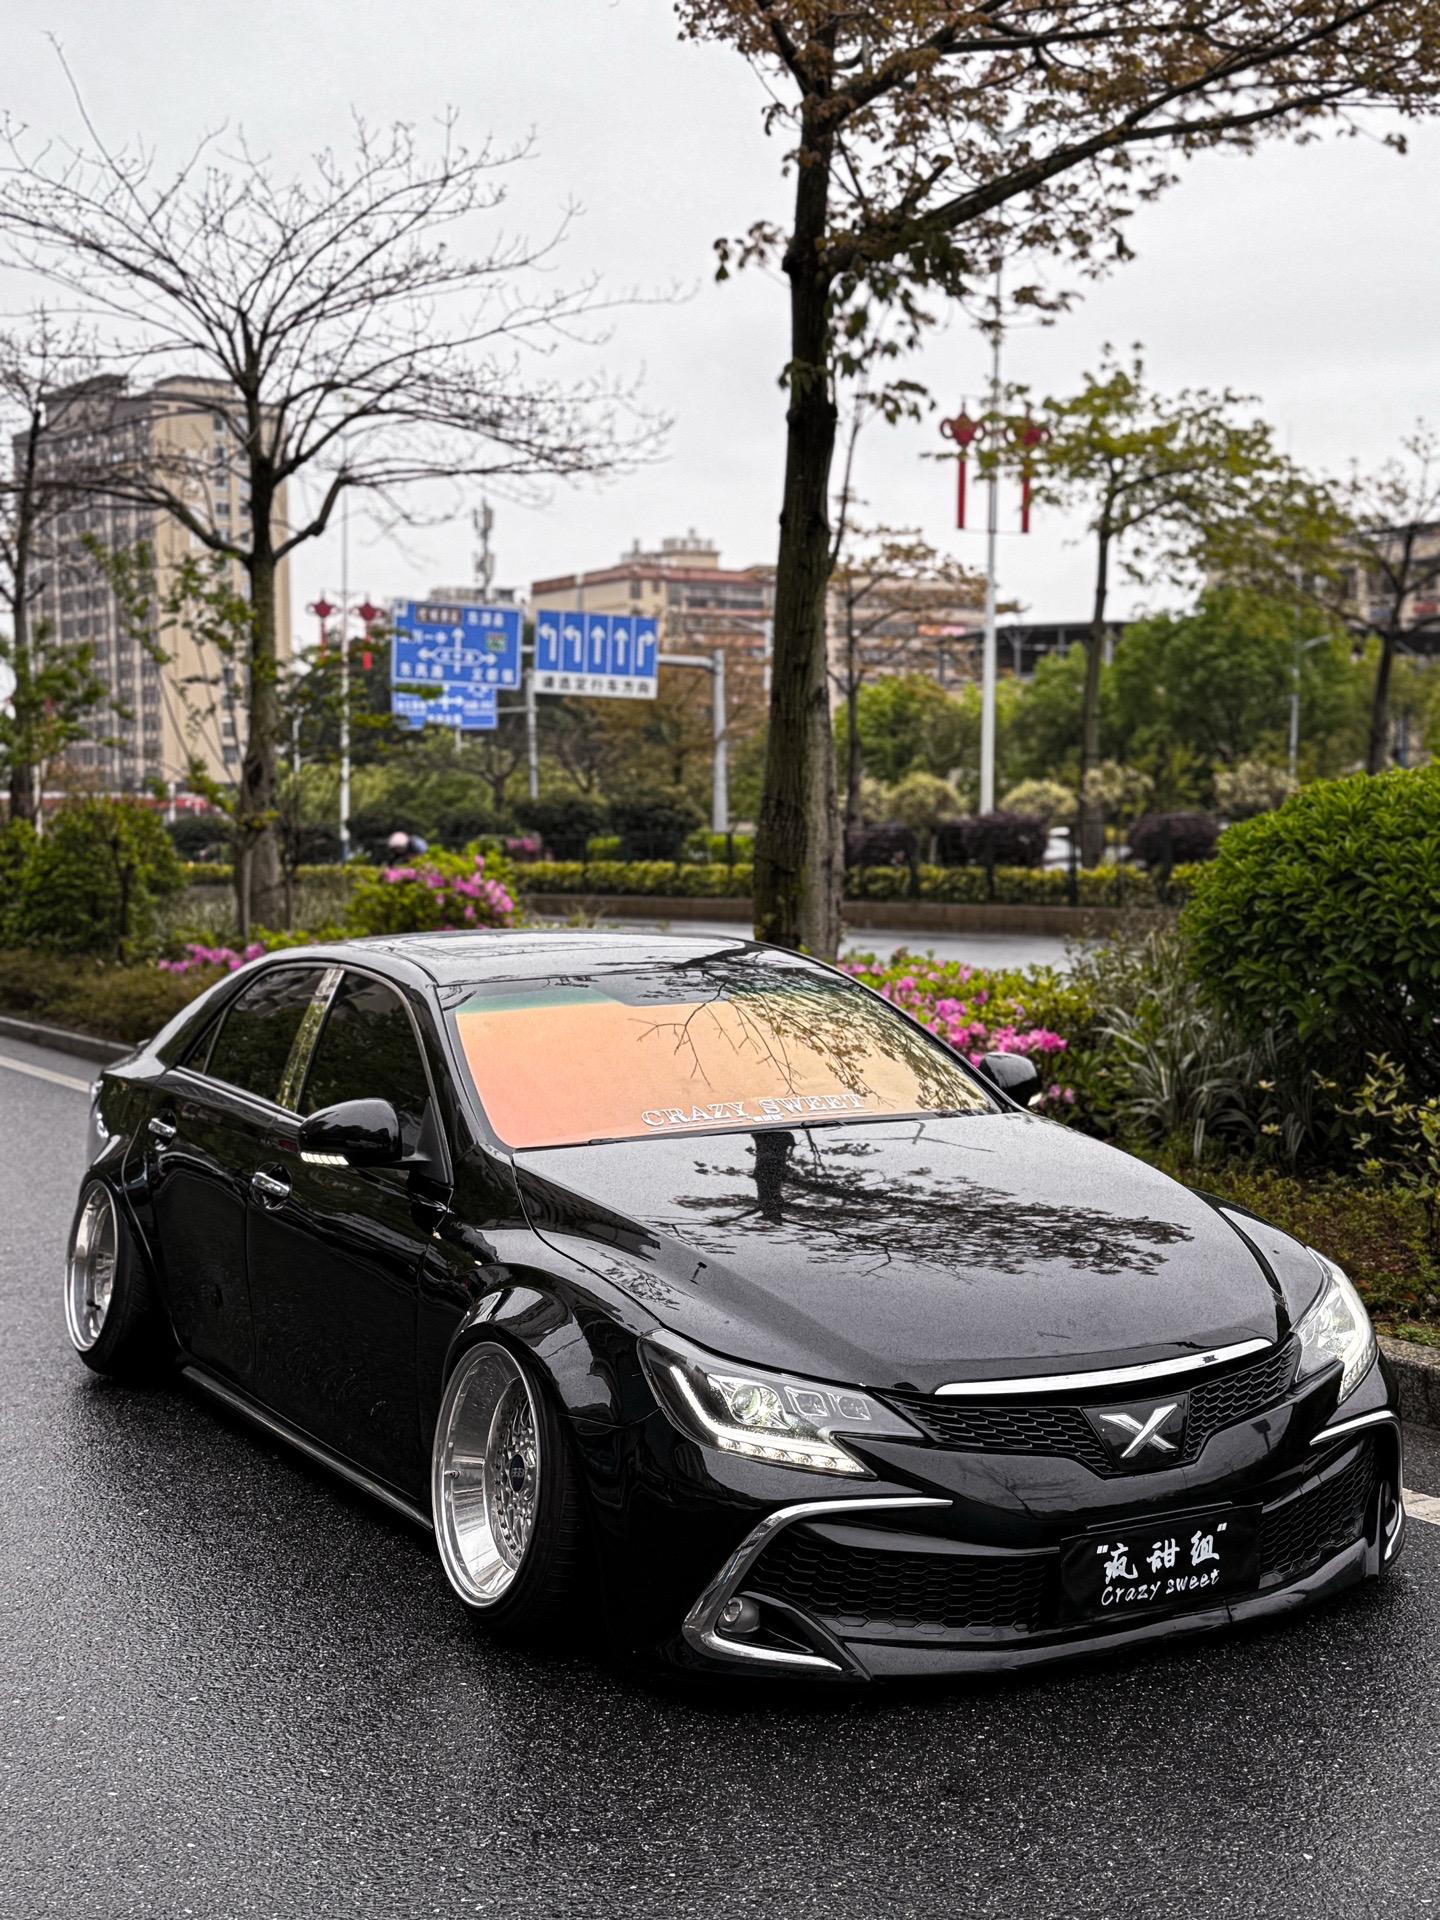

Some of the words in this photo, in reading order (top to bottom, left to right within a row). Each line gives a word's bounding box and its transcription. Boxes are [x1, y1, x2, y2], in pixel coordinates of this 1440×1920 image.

[642, 1101, 749, 1126] CRAZY
[759, 1093, 864, 1115] SWEET
[1101, 1581, 1161, 1606] Crazy
[1165, 1568, 1220, 1594] sweet
